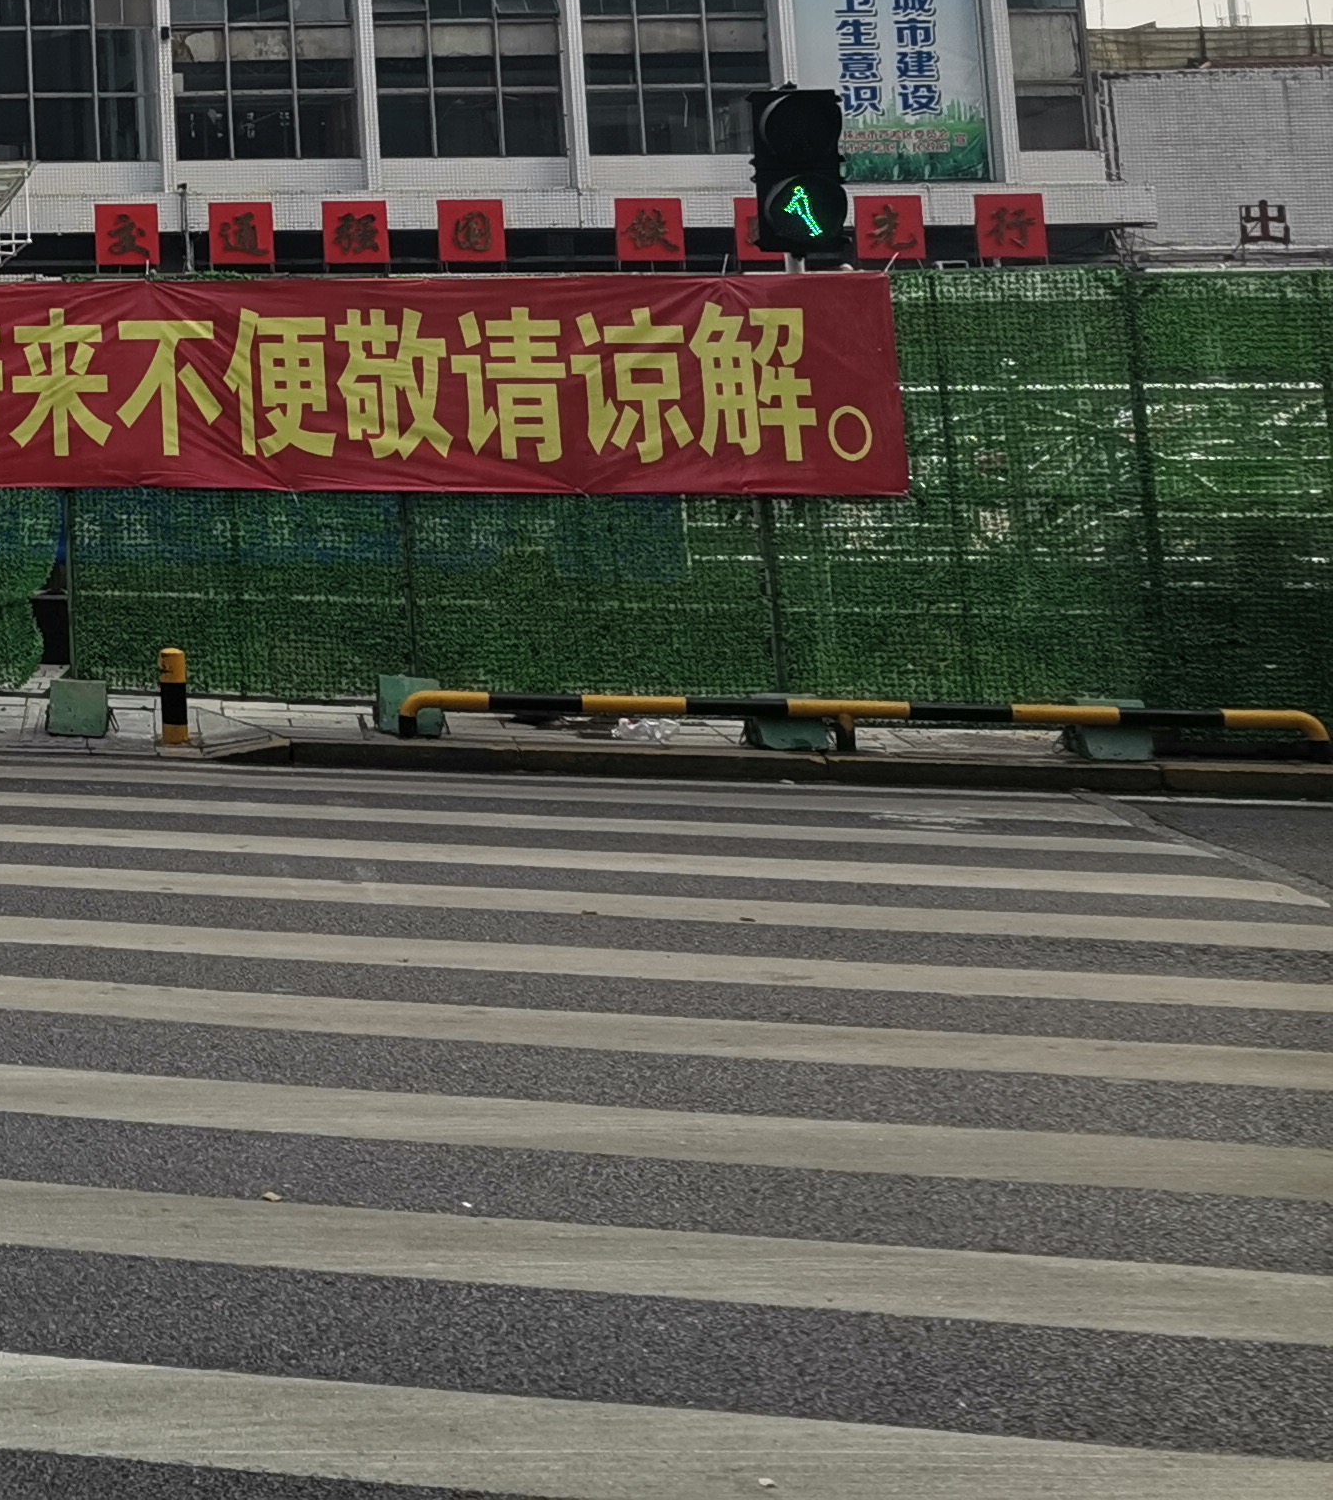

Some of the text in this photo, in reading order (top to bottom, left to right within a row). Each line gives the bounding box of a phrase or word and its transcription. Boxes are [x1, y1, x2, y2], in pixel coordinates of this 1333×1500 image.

[621, 203, 1037, 252] 铁先行
[1240, 199, 1291, 245] 出
